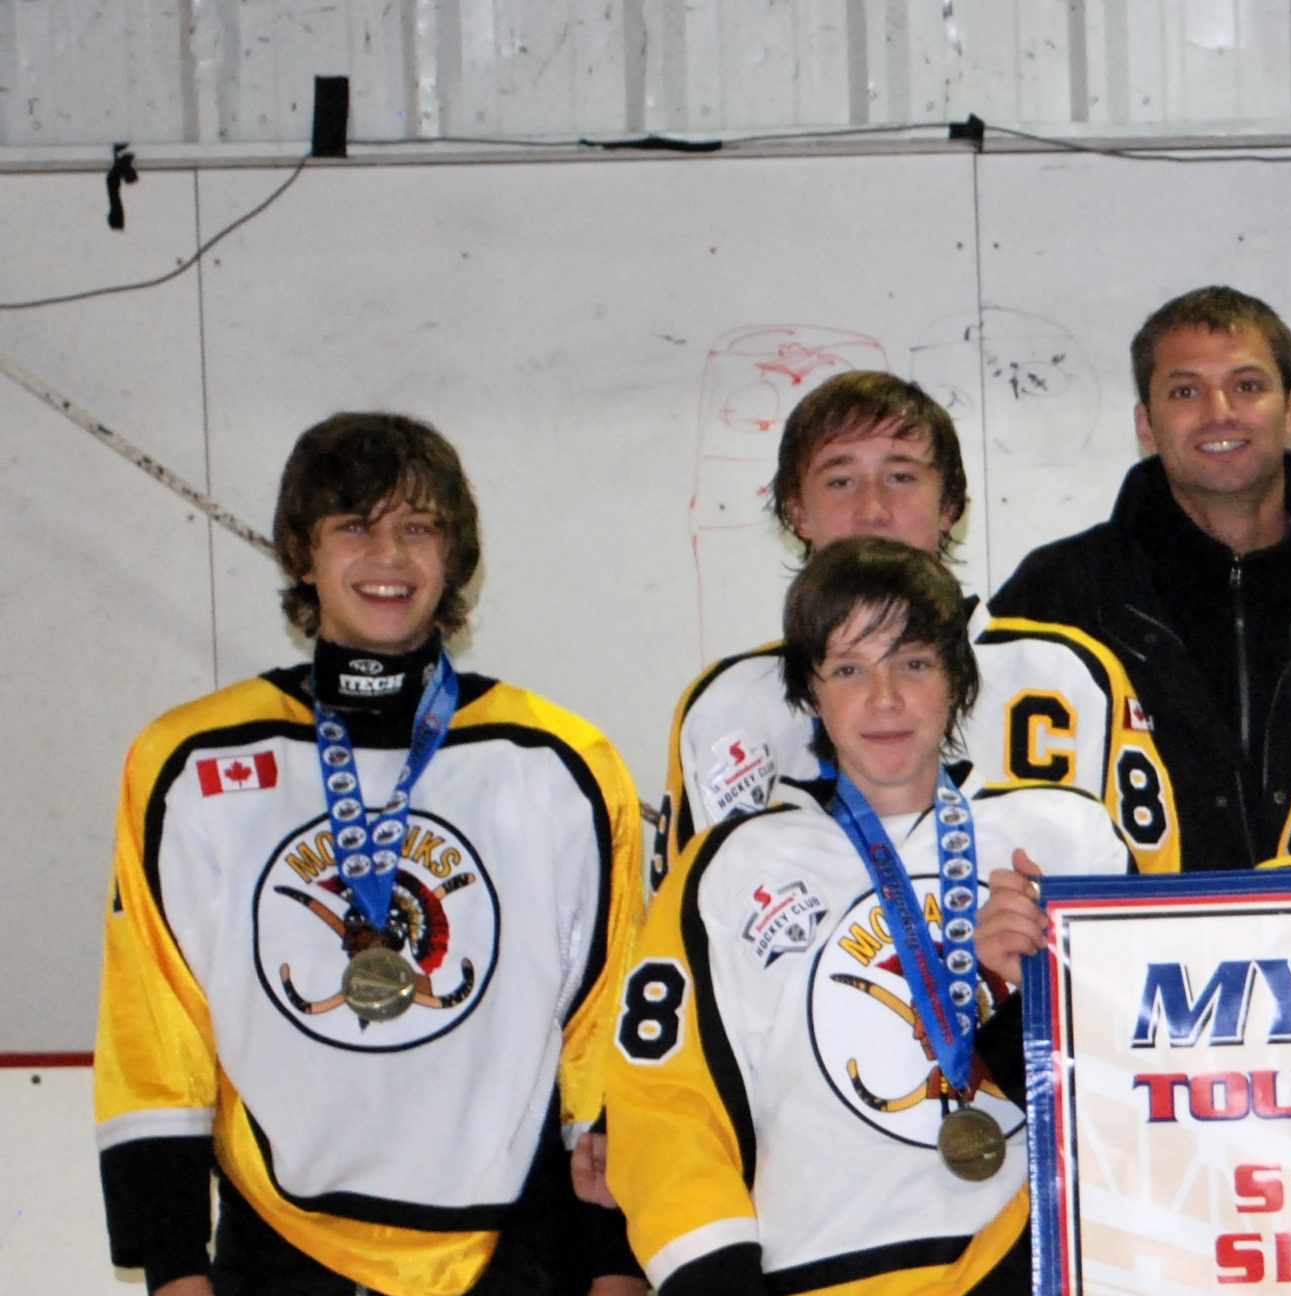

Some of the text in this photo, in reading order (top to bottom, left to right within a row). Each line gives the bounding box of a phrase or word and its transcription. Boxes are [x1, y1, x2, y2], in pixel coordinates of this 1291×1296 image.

[1003, 688, 1078, 786] C
[717, 775, 758, 811] HOCKEY
[1115, 744, 1170, 852] 8
[756, 896, 821, 959] HOCKEY CLUB
[615, 957, 692, 1067] 8
